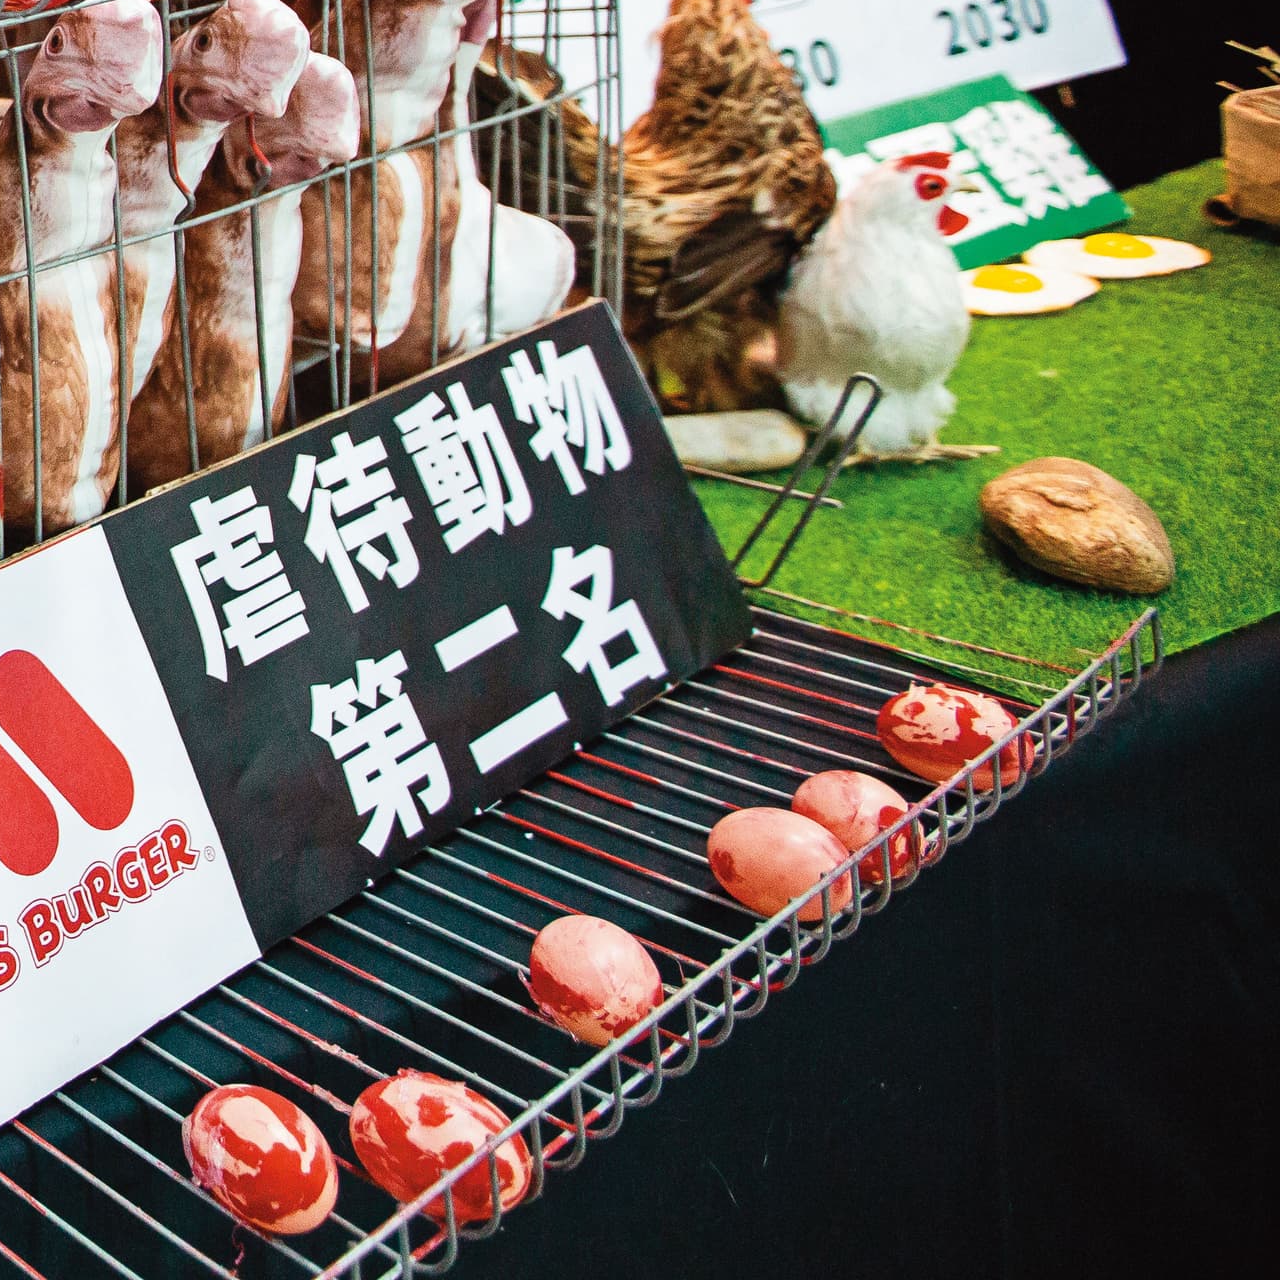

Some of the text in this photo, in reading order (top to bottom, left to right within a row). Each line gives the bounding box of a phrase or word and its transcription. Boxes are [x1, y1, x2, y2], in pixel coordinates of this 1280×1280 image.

[169, 340, 632, 682] 虐待動物
[309, 543, 668, 857] 第二名
[17, 819, 200, 968] BURGER
